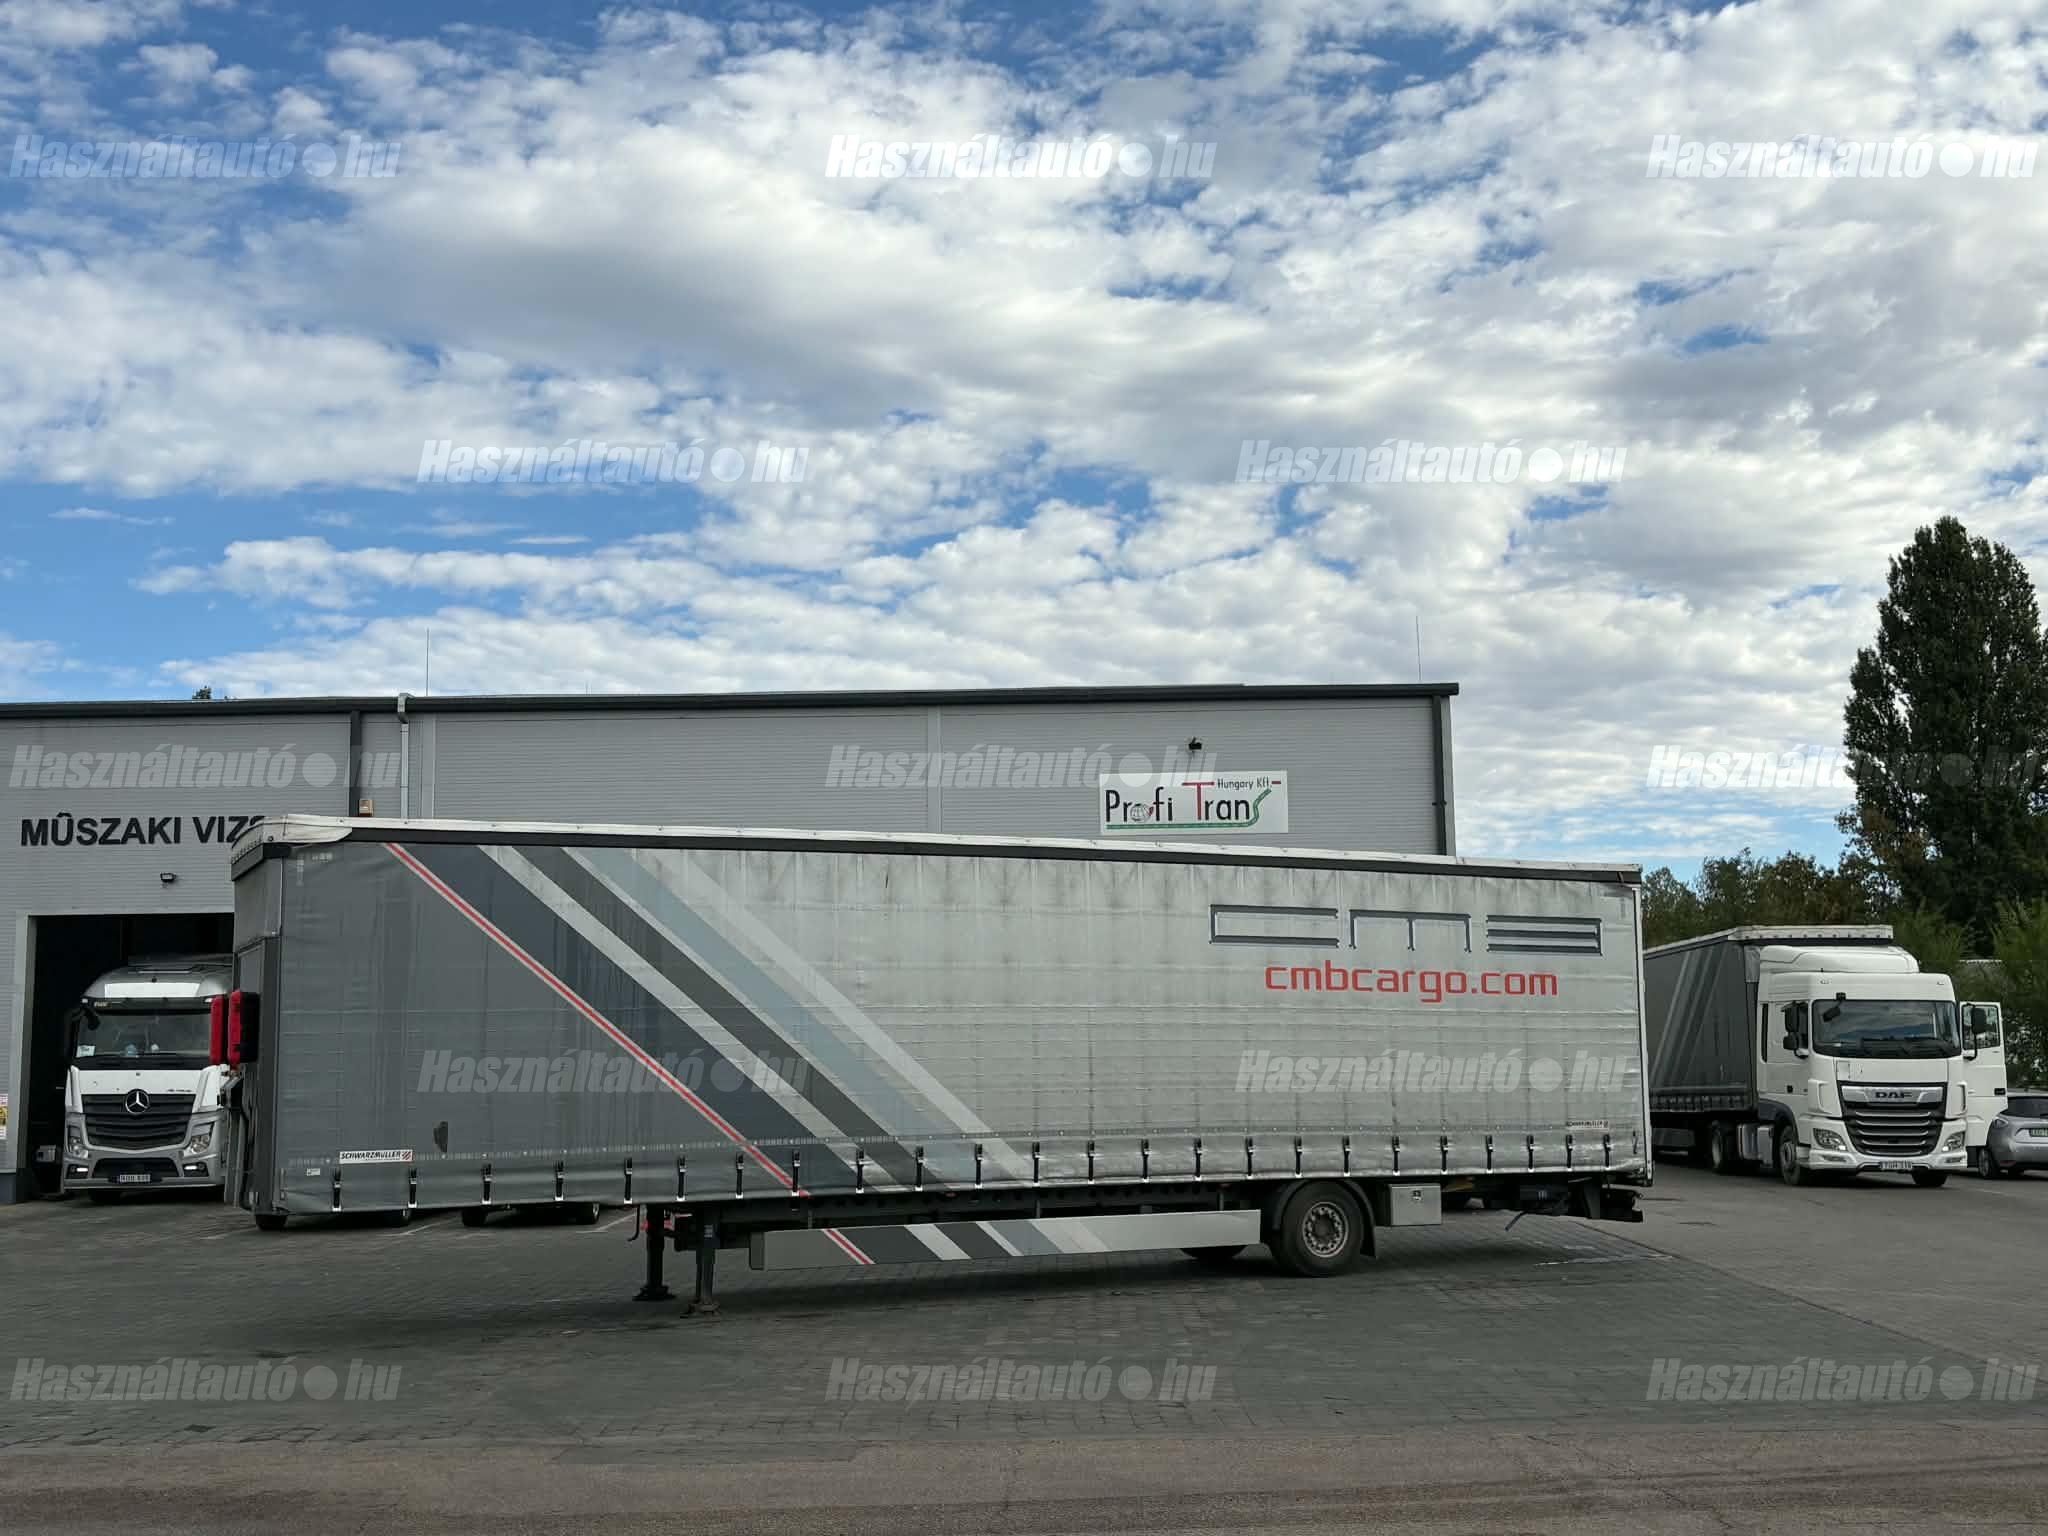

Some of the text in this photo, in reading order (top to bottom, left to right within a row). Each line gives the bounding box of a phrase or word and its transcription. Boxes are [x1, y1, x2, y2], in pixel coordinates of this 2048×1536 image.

[1217, 777, 1254, 791] Hungary
[192, 815, 265, 844] VIZ
[1265, 960, 1558, 1003] cmbcargo.com
[1875, 1091, 1913, 1099] DAF
